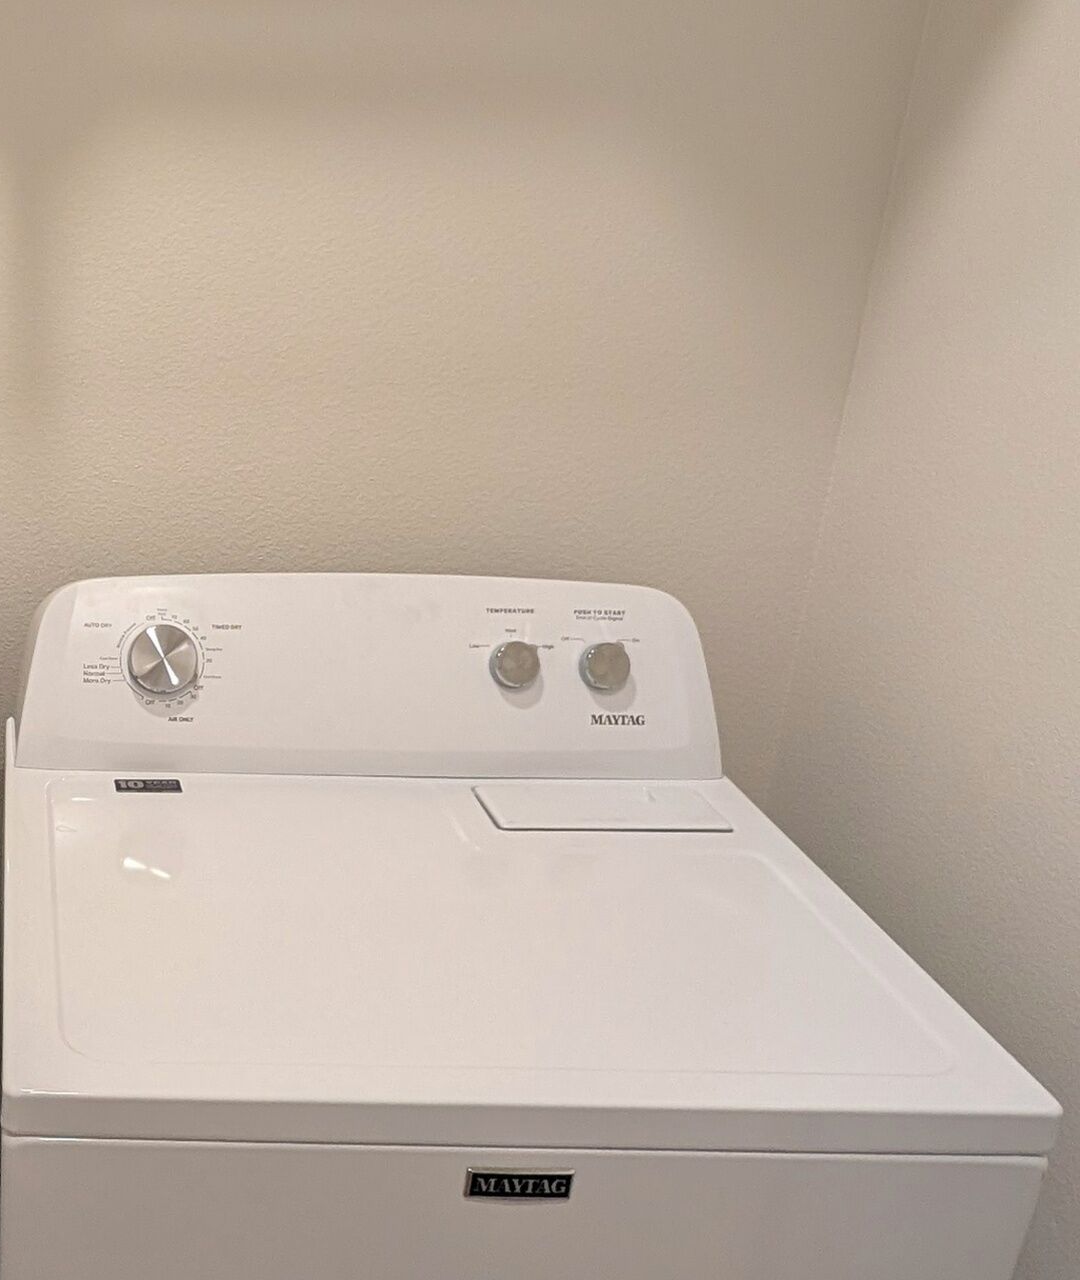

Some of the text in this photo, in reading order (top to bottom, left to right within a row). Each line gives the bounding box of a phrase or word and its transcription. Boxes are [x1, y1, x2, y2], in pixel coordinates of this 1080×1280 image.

[590, 714, 645, 726] MAYTAG
[118, 780, 145, 789] 10
[473, 1177, 567, 1194] MAYTAG
